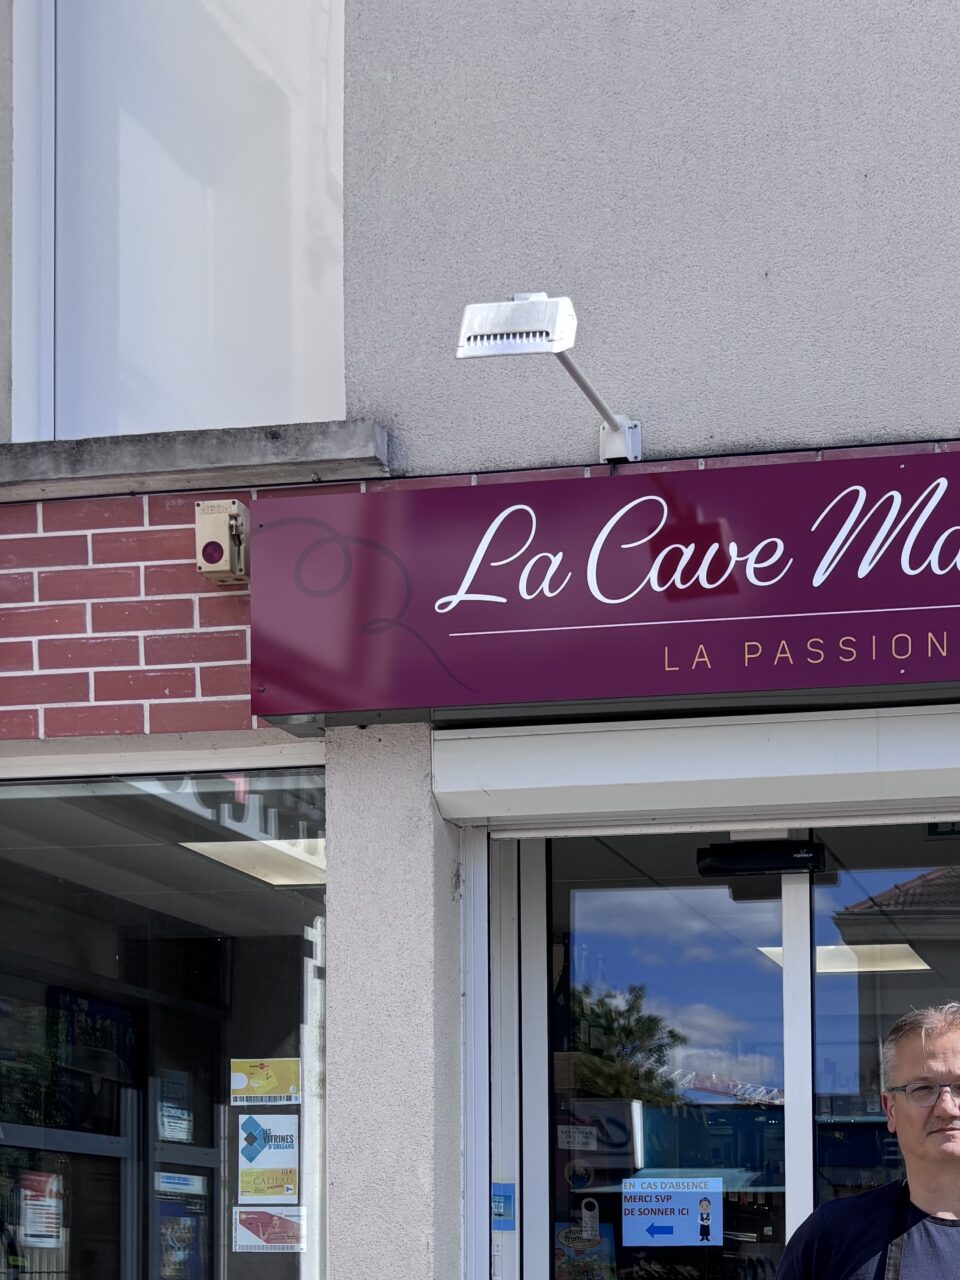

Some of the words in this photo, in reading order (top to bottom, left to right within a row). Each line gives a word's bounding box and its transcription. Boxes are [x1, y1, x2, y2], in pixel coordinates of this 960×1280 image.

[435, 504, 572, 613] La
[586, 495, 794, 604] Cave
[663, 644, 712, 671] LA
[744, 631, 948, 667] PASSION
[263, 1134, 295, 1144] VITRINES
[660, 1181, 708, 1189] D'ABSENCE
[623, 1195, 652, 1203] MERCI
[655, 1195, 672, 1203] SVP
[623, 1208, 635, 1216] DE
[638, 1208, 675, 1216] SONNER
[678, 1208, 689, 1216] ICI
